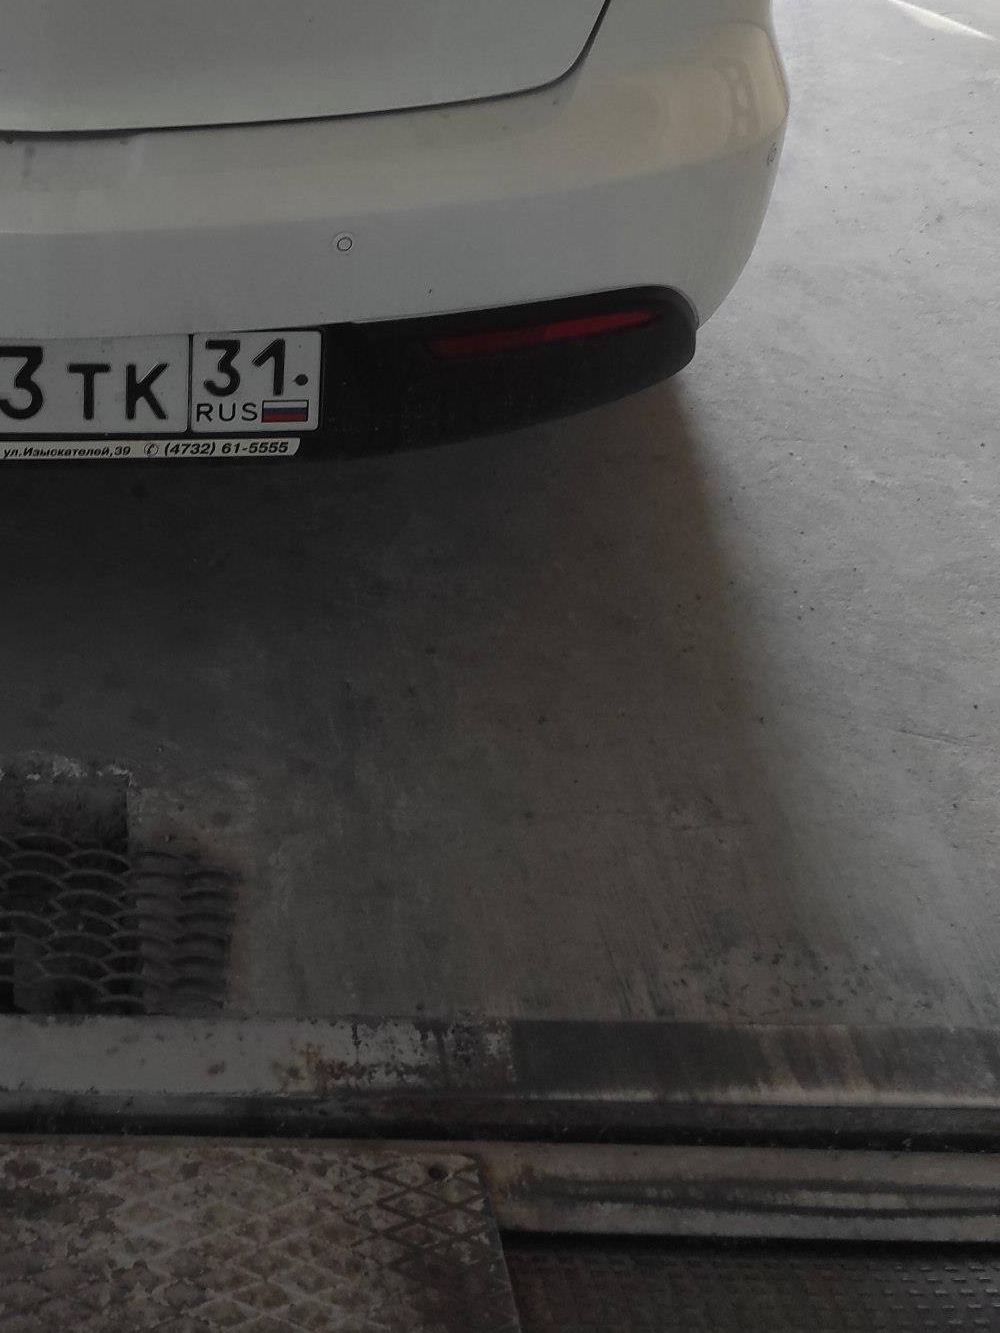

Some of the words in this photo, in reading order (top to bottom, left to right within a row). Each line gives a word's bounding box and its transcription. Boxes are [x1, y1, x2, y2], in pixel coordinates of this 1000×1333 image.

[202, 339, 286, 397] 31
[196, 403, 258, 422] RUS
[164, 442, 216, 456] (4732)
[221, 441, 289, 455] 61-5555
